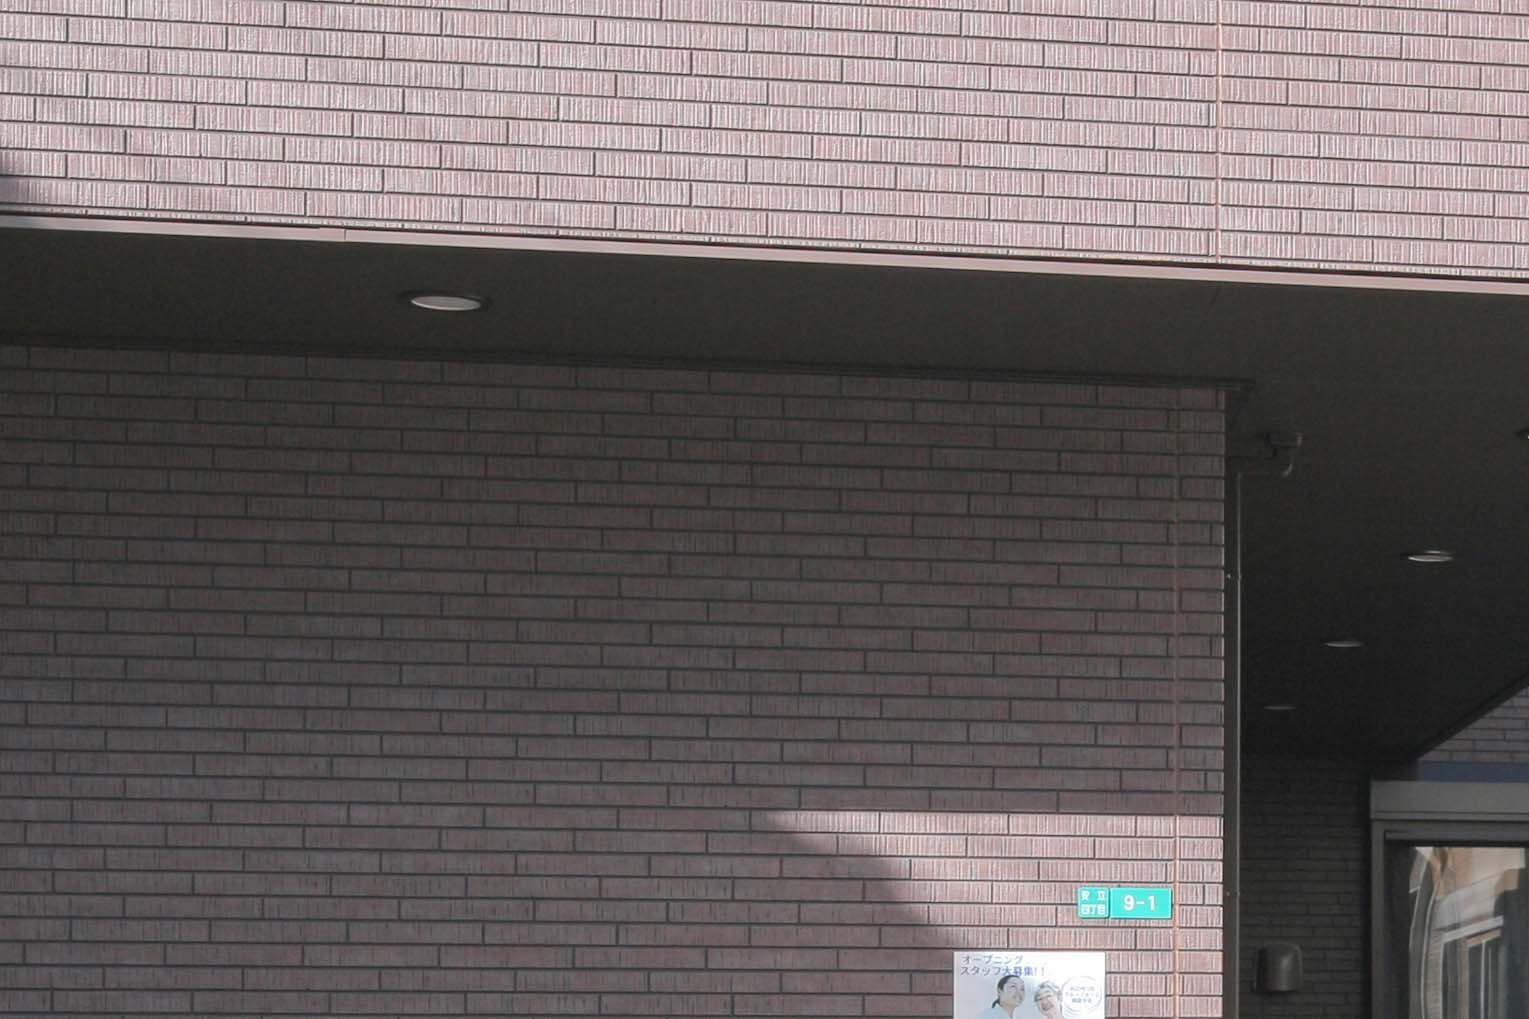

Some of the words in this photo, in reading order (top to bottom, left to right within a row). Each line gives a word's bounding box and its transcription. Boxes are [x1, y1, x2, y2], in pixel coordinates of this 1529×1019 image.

[1123, 894, 1156, 911] 9-1
[961, 955, 1024, 965] オープニング
